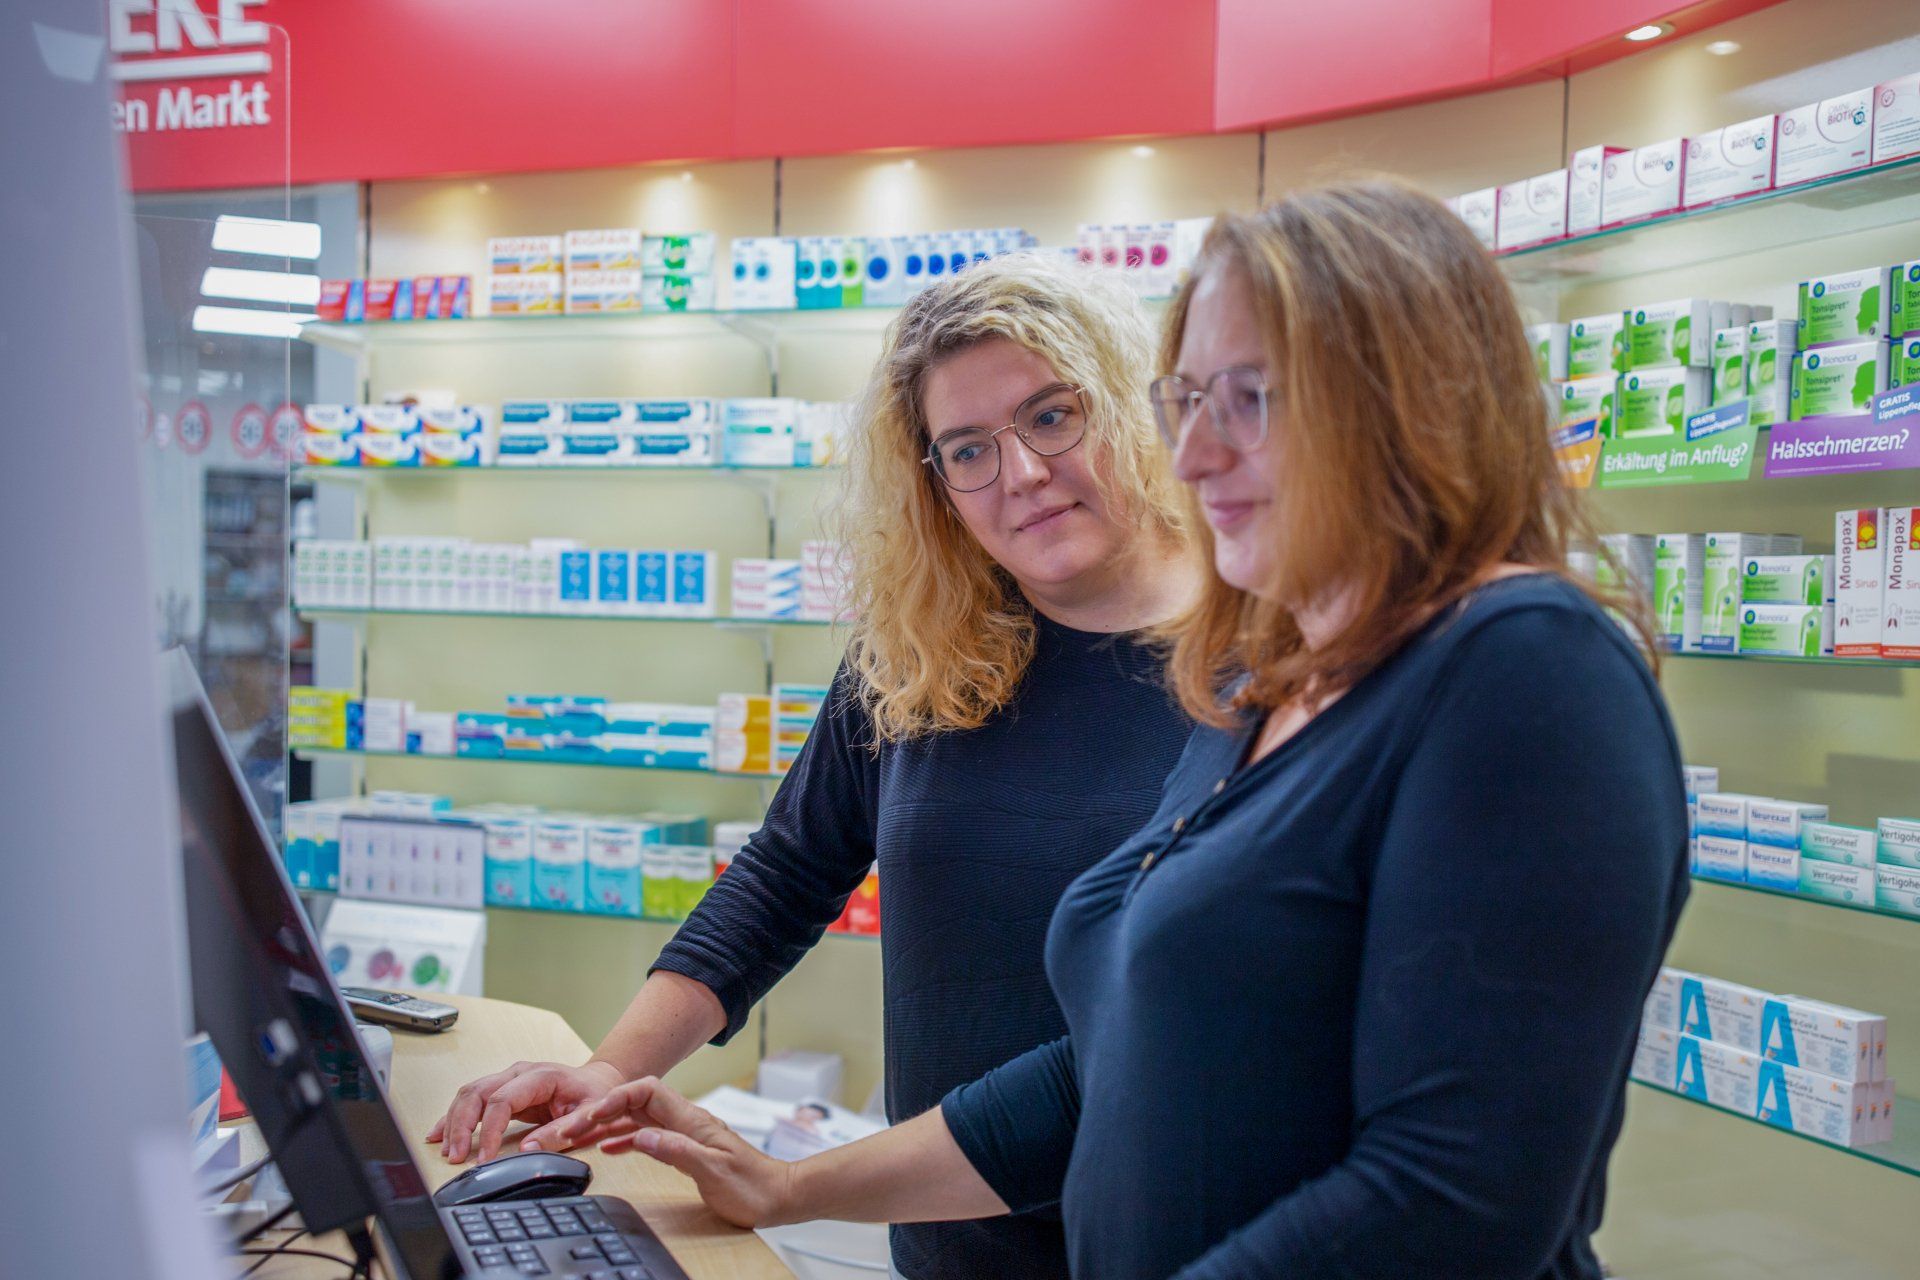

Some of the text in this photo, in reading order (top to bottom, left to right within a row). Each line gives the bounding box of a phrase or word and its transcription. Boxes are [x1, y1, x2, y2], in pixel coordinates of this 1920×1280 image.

[155, 79, 271, 132] Markt
[1879, 392, 1911, 409] GRATIS
[1771, 428, 1909, 460] Halsschmerzen?
[1604, 449, 1667, 475] Erkältung
[1670, 448, 1688, 466] im
[1691, 442, 1748, 468] Anflug?
[1839, 518, 1854, 590] Monapax
[1889, 516, 1907, 590] Monapax
[1855, 577, 1878, 589] Sirup
[1701, 803, 1739, 815] Neurexan
[1751, 808, 1791, 823] Neurexan
[1813, 832, 1858, 848] Vertigoheel
[1701, 842, 1739, 856] Neurexan
[1752, 849, 1793, 865] Neurexan
[1812, 868, 1858, 885] Vertigoheel
